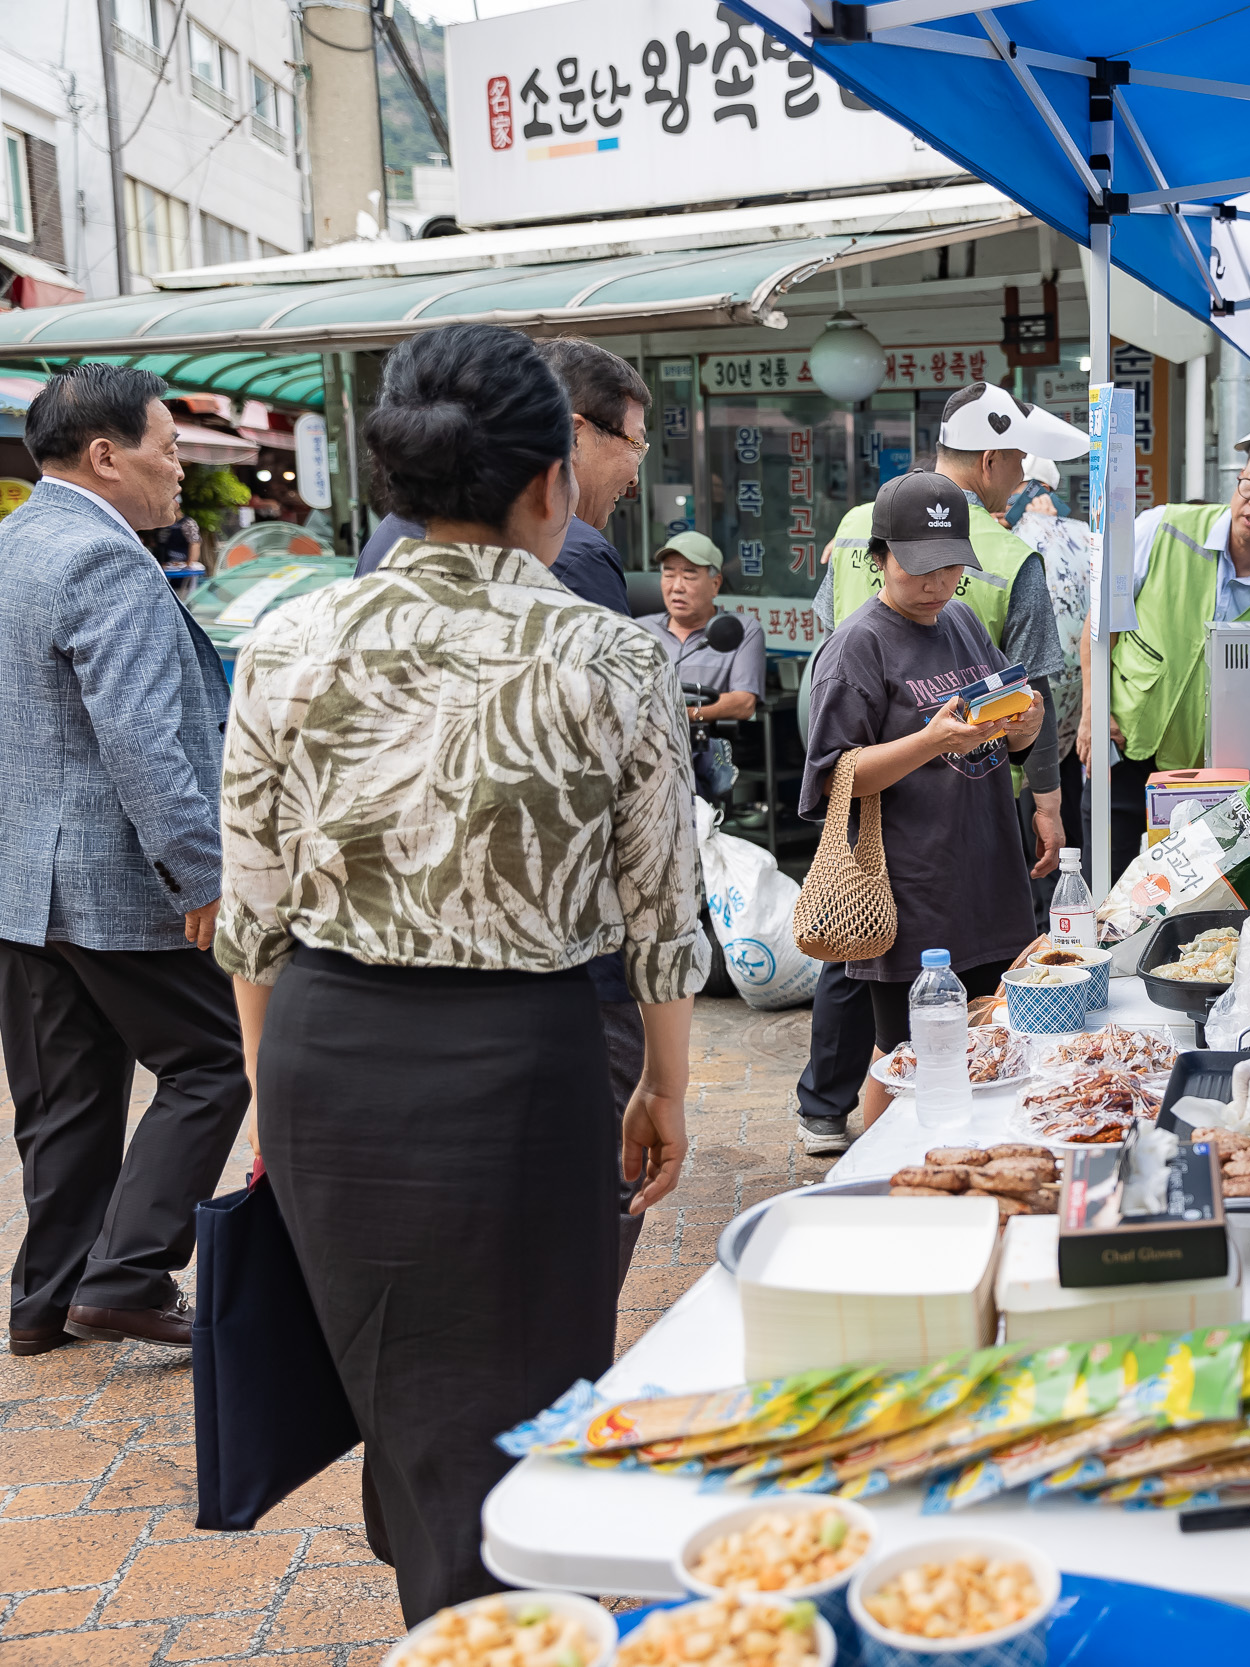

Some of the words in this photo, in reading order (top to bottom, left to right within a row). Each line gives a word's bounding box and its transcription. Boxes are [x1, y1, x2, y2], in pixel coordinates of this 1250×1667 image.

[489, 79, 511, 149] 名家
[520, 58, 631, 140] 소문난
[715, 361, 752, 387] 30년
[759, 359, 788, 385] 전통
[735, 426, 763, 577] 왕족발
[788, 427, 815, 580] 머리고기
[1150, 829, 1204, 893] 왕교자
[1137, 1247, 1183, 1261] Gloves
